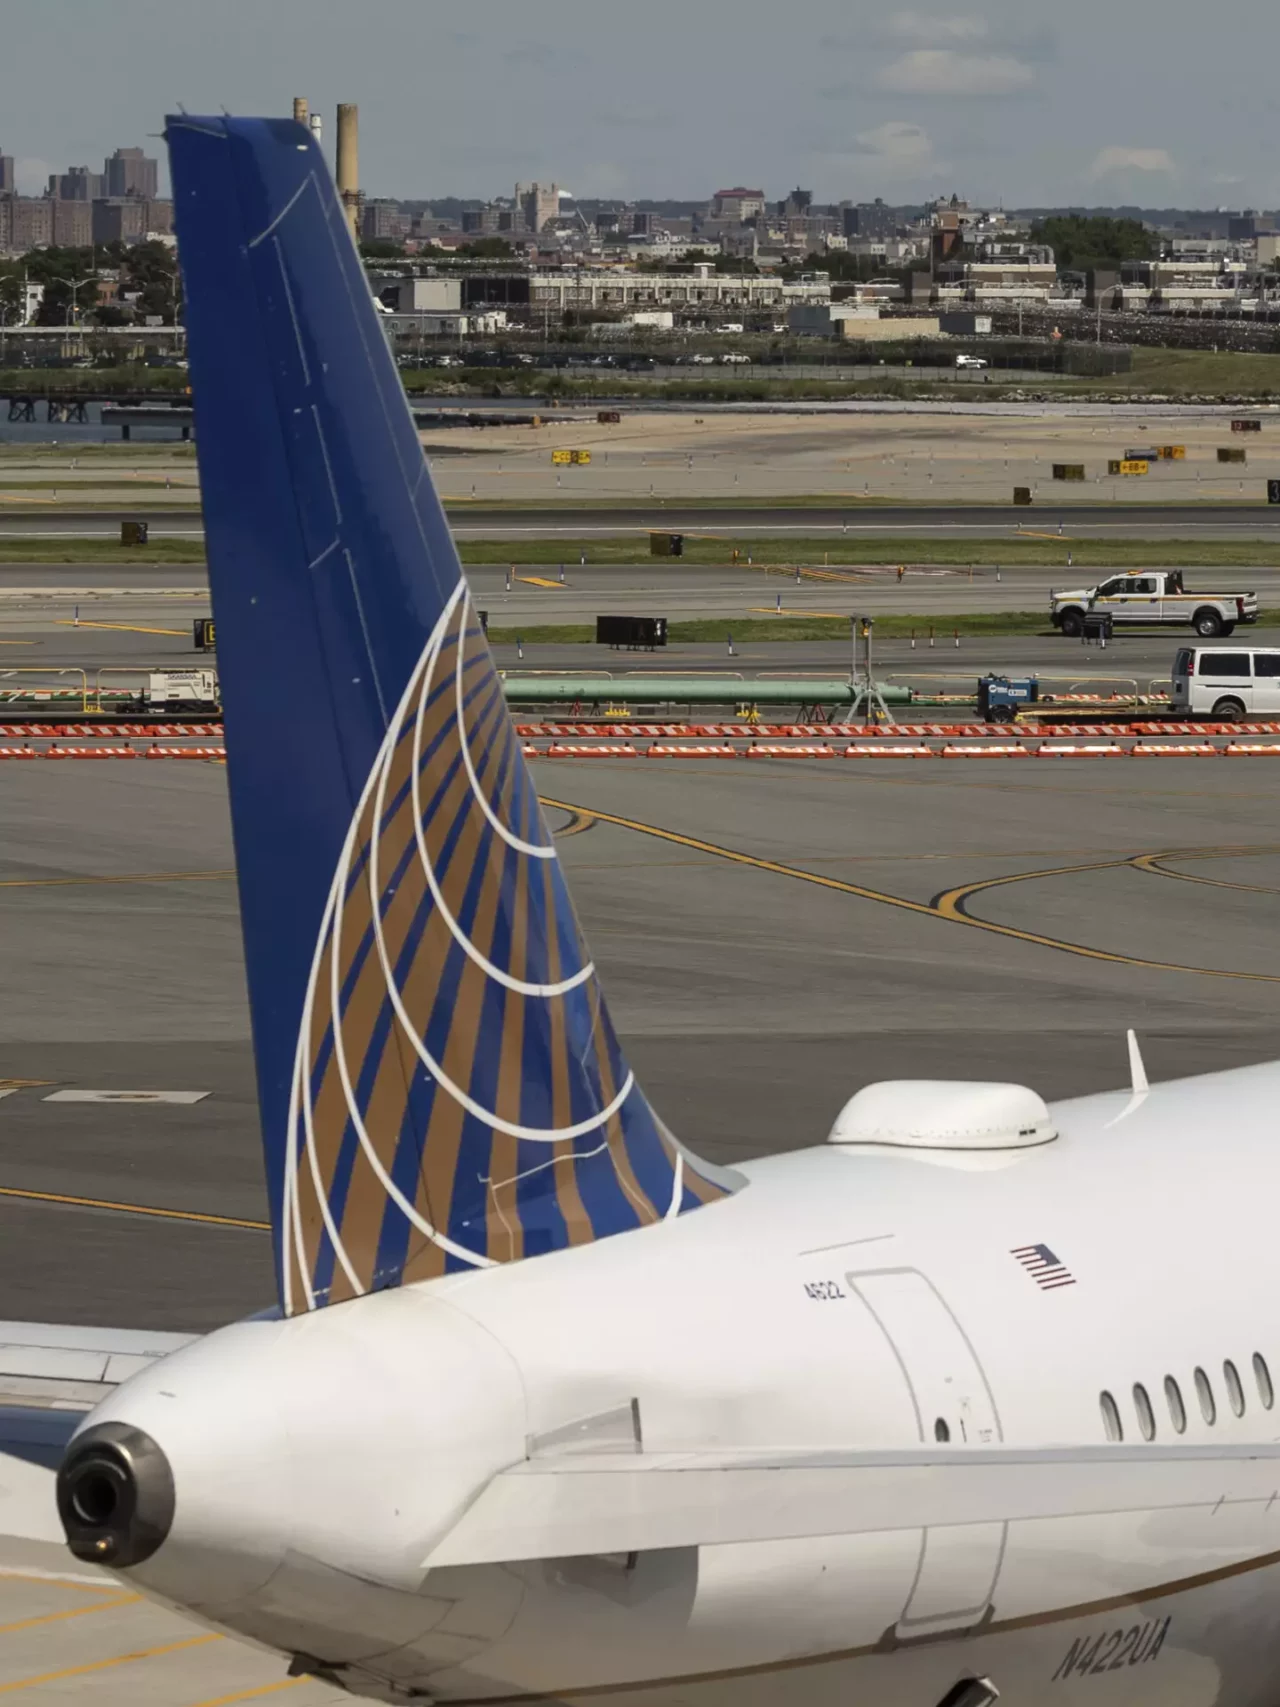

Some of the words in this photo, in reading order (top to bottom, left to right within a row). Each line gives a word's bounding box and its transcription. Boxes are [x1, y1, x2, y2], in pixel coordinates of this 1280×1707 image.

[1271, 482, 1280, 502] 3
[803, 1280, 846, 1302] 4622
[1050, 1614, 1173, 1683] N422UA
